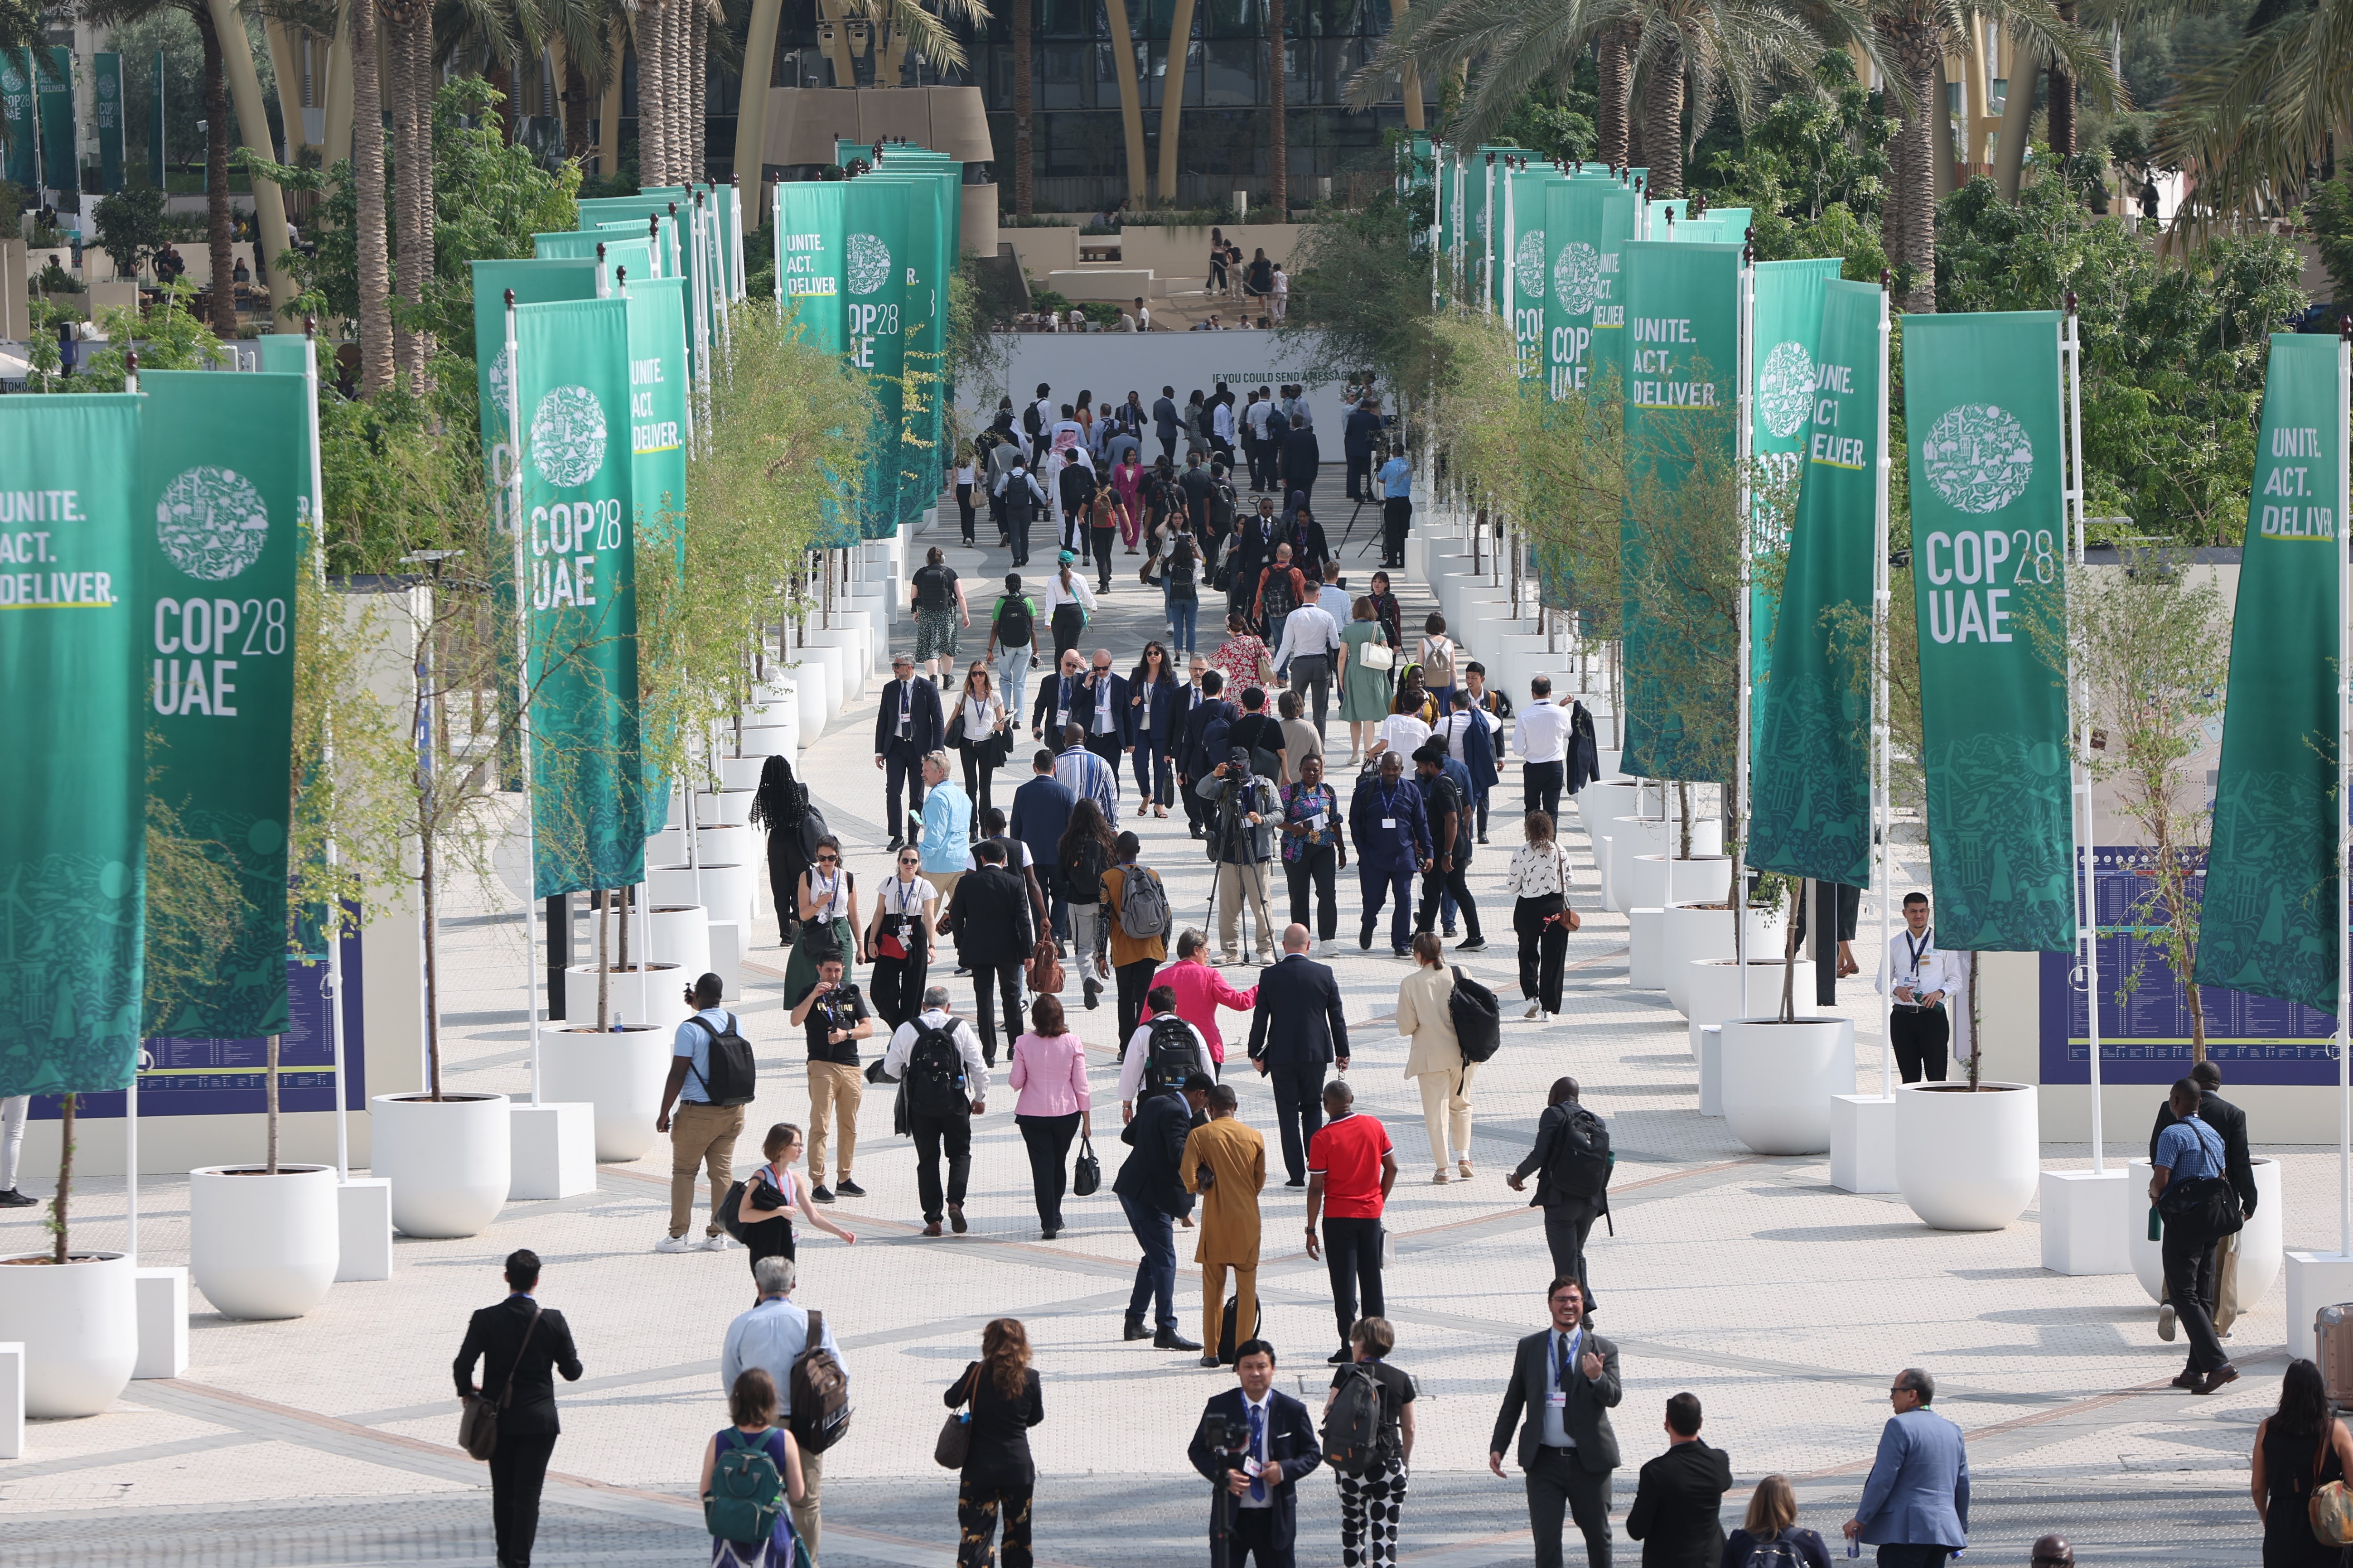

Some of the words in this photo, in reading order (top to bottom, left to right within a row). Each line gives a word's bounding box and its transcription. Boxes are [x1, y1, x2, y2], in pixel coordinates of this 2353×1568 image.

[41, 84, 67, 92] DELIVER.
[99, 115, 114, 128] UAE
[787, 233, 824, 251] UNITE.
[787, 255, 814, 273] ACT.
[1598, 252, 1619, 273] UNITE.
[788, 276, 837, 294] DELIVER.
[1595, 279, 1611, 300] ACT.
[1593, 305, 1624, 326] DELIVER.
[1633, 318, 1696, 343] UNITE.
[631, 357, 664, 386] UNITE.
[1633, 349, 1672, 374] ACT.
[1222, 373, 1242, 384] YOU
[1243, 372, 1273, 383] COULD
[1276, 371, 1300, 382] SEND
[631, 391, 653, 419] ACT.
[1633, 380, 1720, 407] DELIVER.
[633, 421, 683, 450] DELIVER.
[2271, 428, 2321, 458] UNITE.
[2263, 467, 2311, 497] ACT.
[0, 489, 87, 522] UNITE.
[531, 498, 622, 556] COP28
[2261, 505, 2334, 538] DELIVER.
[0, 531, 57, 564] ACT.
[1926, 528, 2054, 585] COP28
[0, 572, 118, 604] DELIVER.
[532, 555, 597, 612] UAE
[154, 596, 286, 656] COP28
[1928, 589, 2013, 644] UAE
[153, 659, 237, 716] UAE
